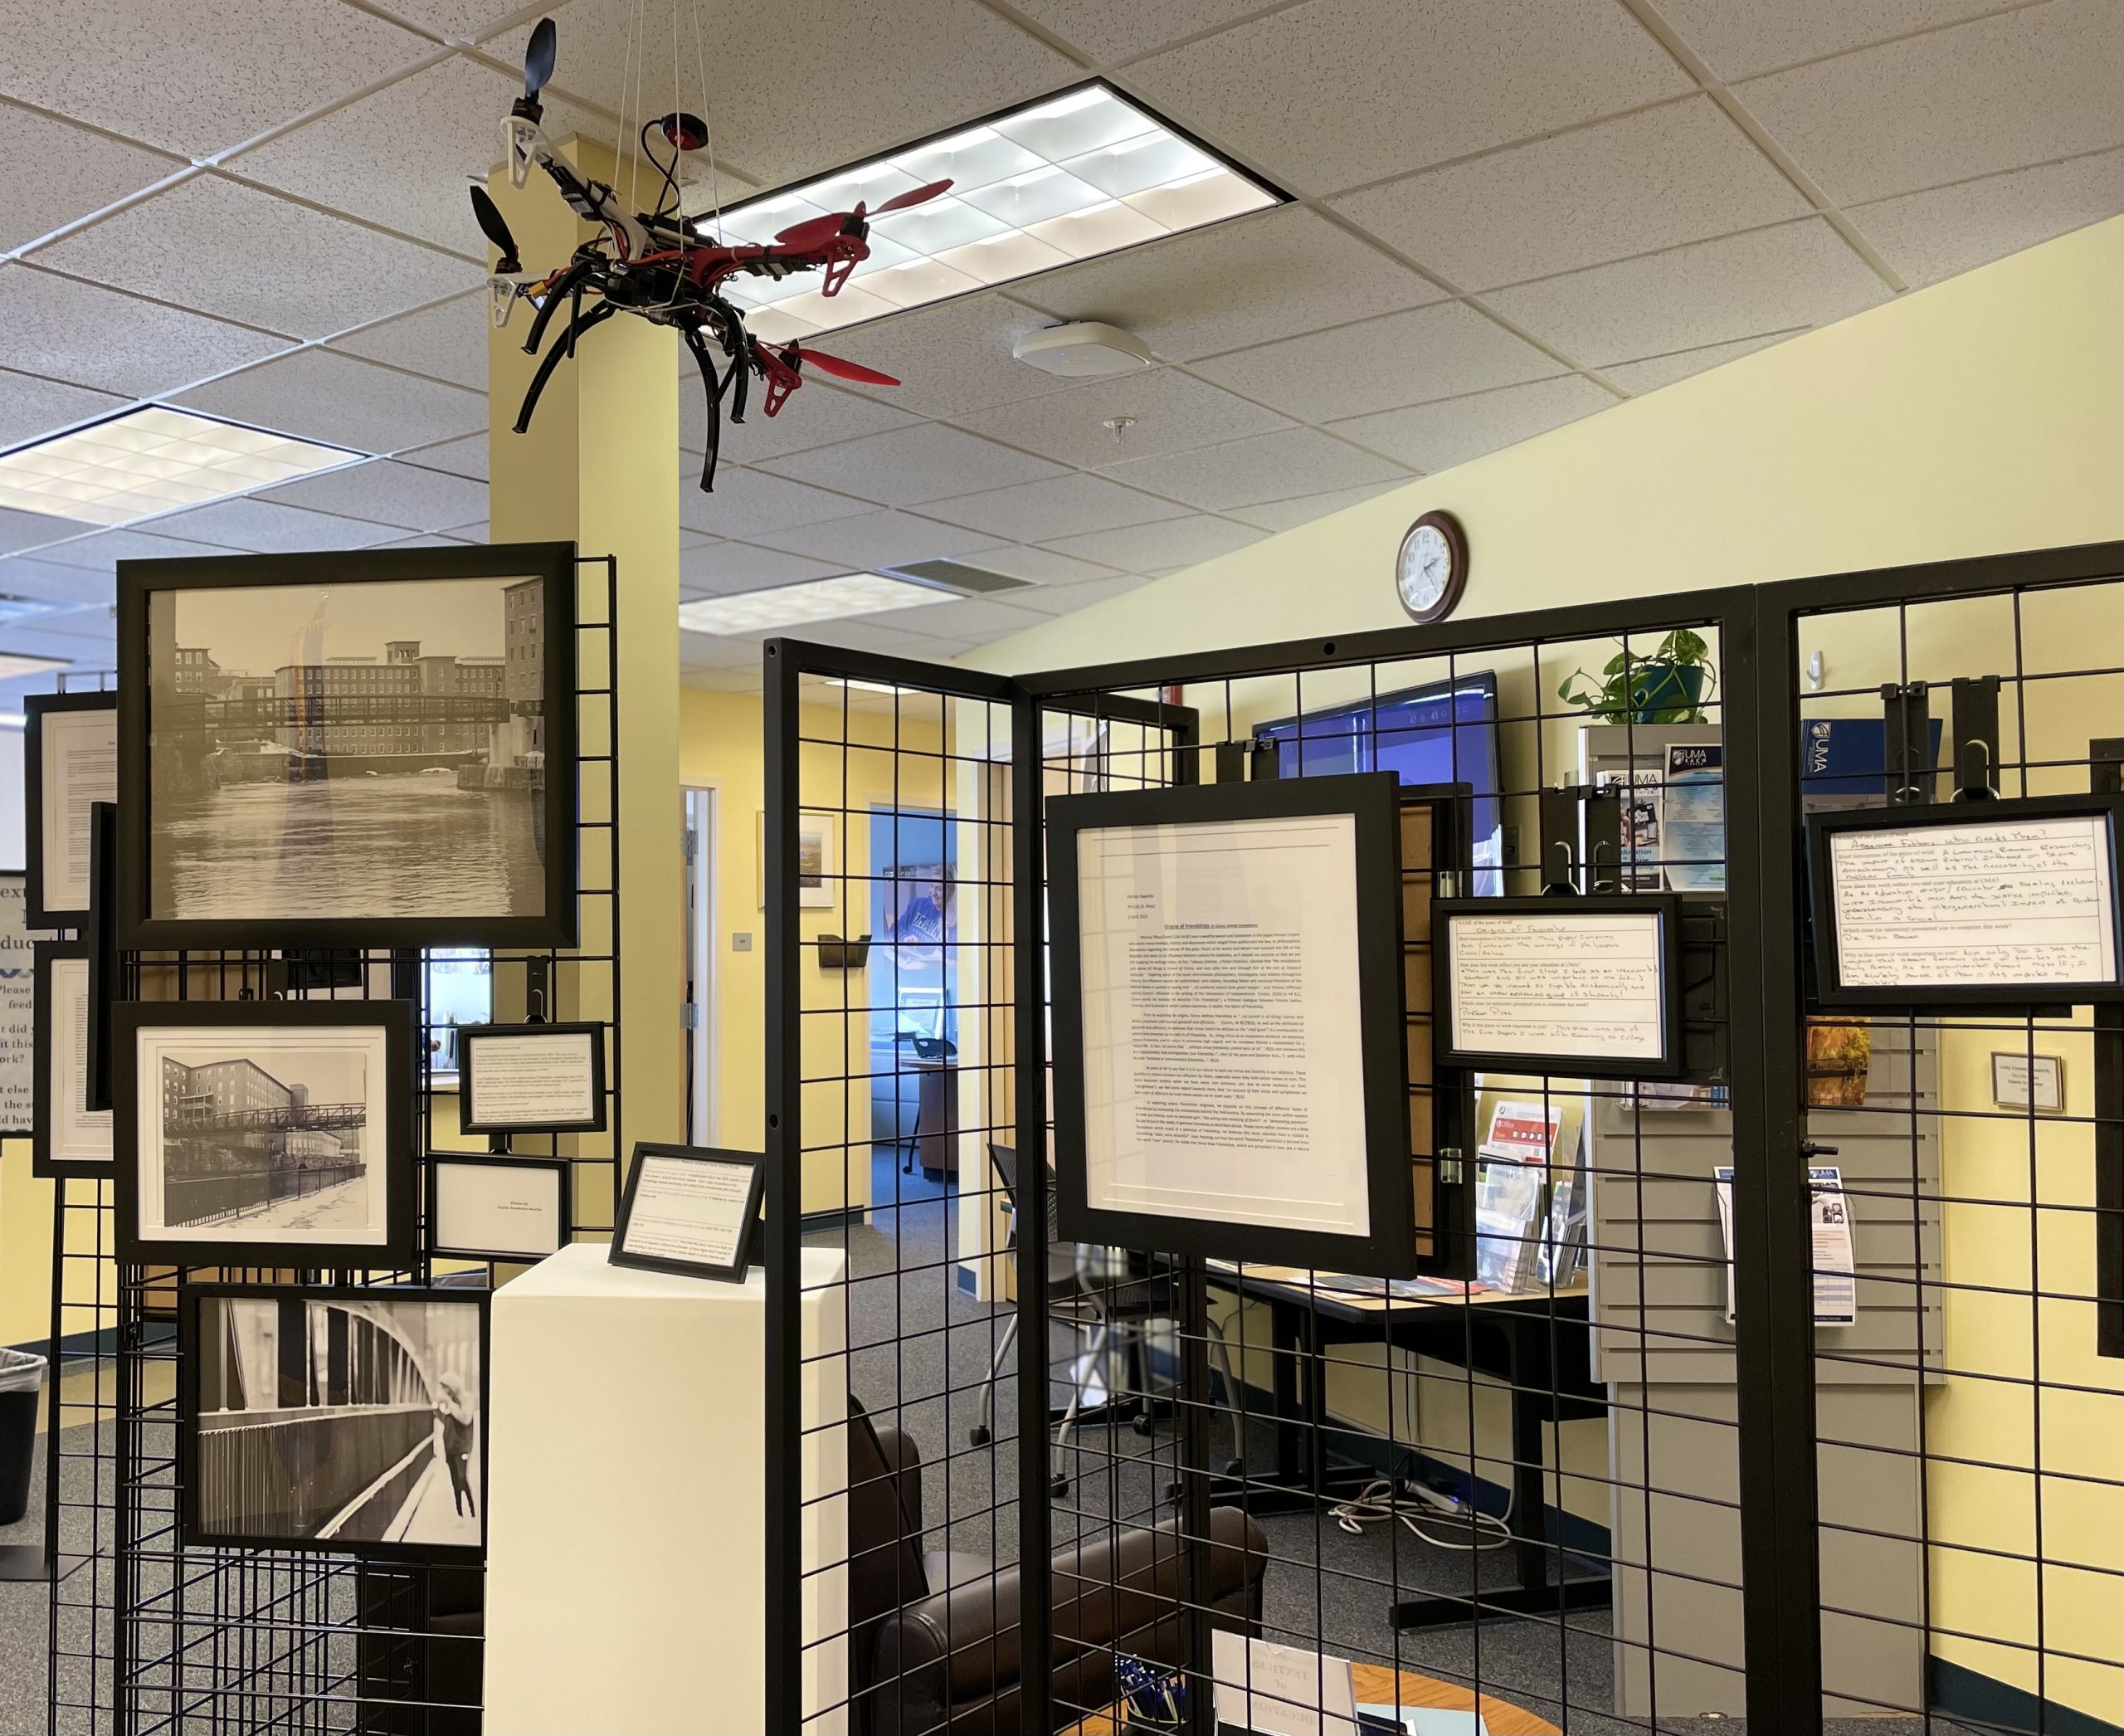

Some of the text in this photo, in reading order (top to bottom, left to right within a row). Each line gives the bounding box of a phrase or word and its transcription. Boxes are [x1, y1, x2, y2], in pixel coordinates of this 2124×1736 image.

[1685, 749, 1707, 758] UMA
[1814, 739, 1829, 773] UMA
[911, 913, 943, 943] MAIN
[0, 935, 37, 949] duc
[8, 999, 32, 1009] feed
[9, 1024, 27, 1033] did
[12, 1039, 33, 1049] this
[7, 1085, 29, 1094] else
[5, 1100, 22, 1109] the
